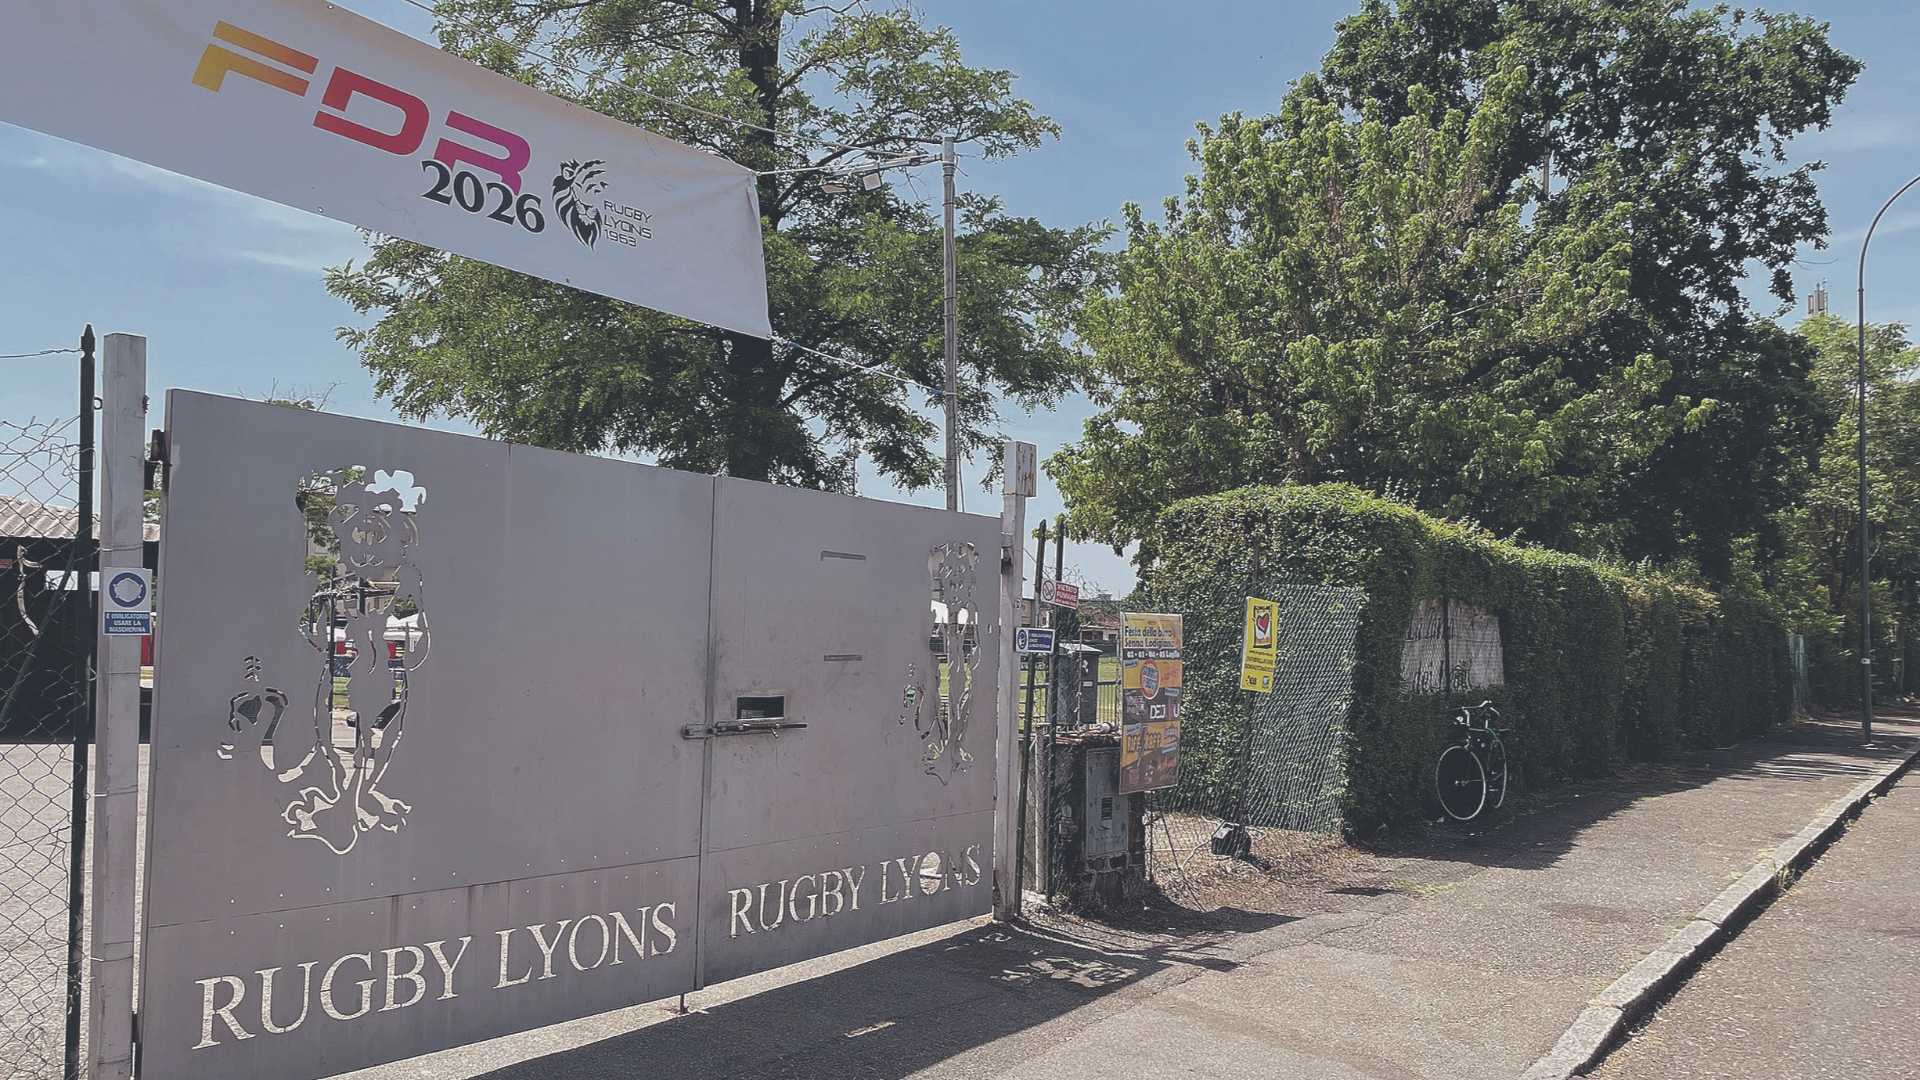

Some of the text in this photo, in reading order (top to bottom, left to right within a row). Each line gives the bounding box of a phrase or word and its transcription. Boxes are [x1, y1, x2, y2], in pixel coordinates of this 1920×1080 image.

[192, 20, 532, 196] FDR
[421, 160, 546, 234] 2026
[604, 200, 653, 223] RUGBY
[604, 214, 652, 239] LYONS
[728, 844, 981, 939] RUGBY LYONS
[192, 902, 677, 1050] RUGBY LYONS
